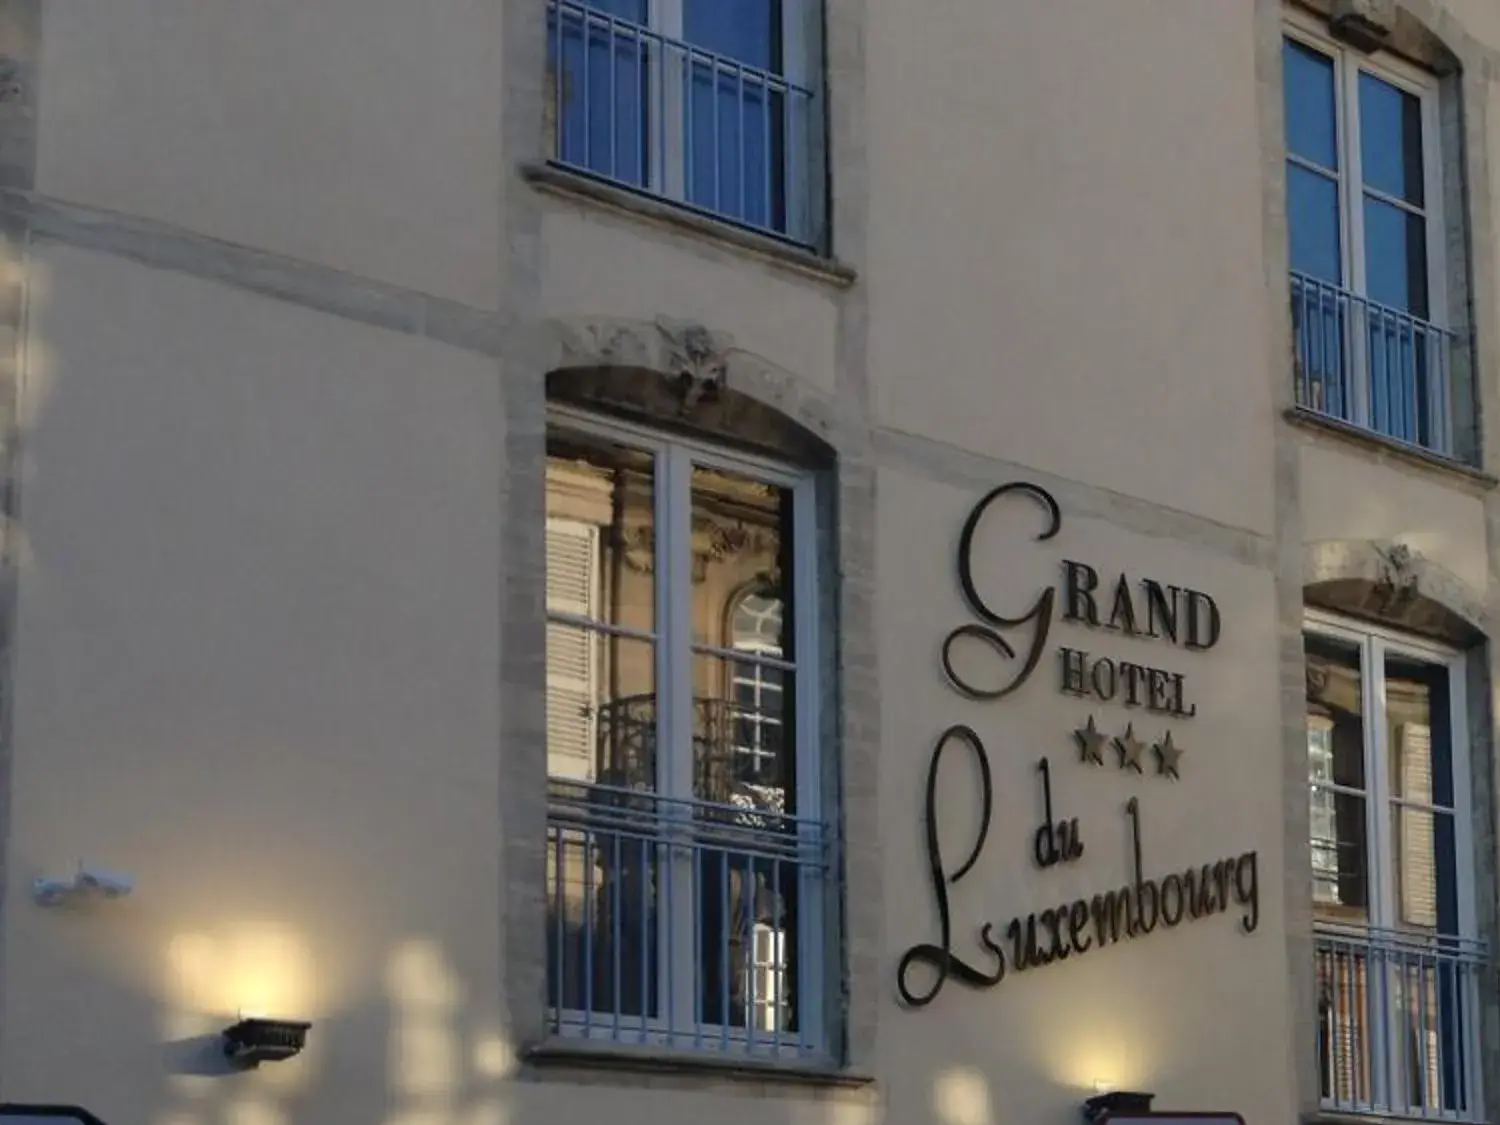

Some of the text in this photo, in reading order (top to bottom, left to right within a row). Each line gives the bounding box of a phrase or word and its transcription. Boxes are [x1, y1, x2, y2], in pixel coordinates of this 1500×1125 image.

[1059, 647, 1196, 718] HOTEL
[898, 725, 1259, 1006] Luxembourg
[1034, 757, 1084, 868] du
